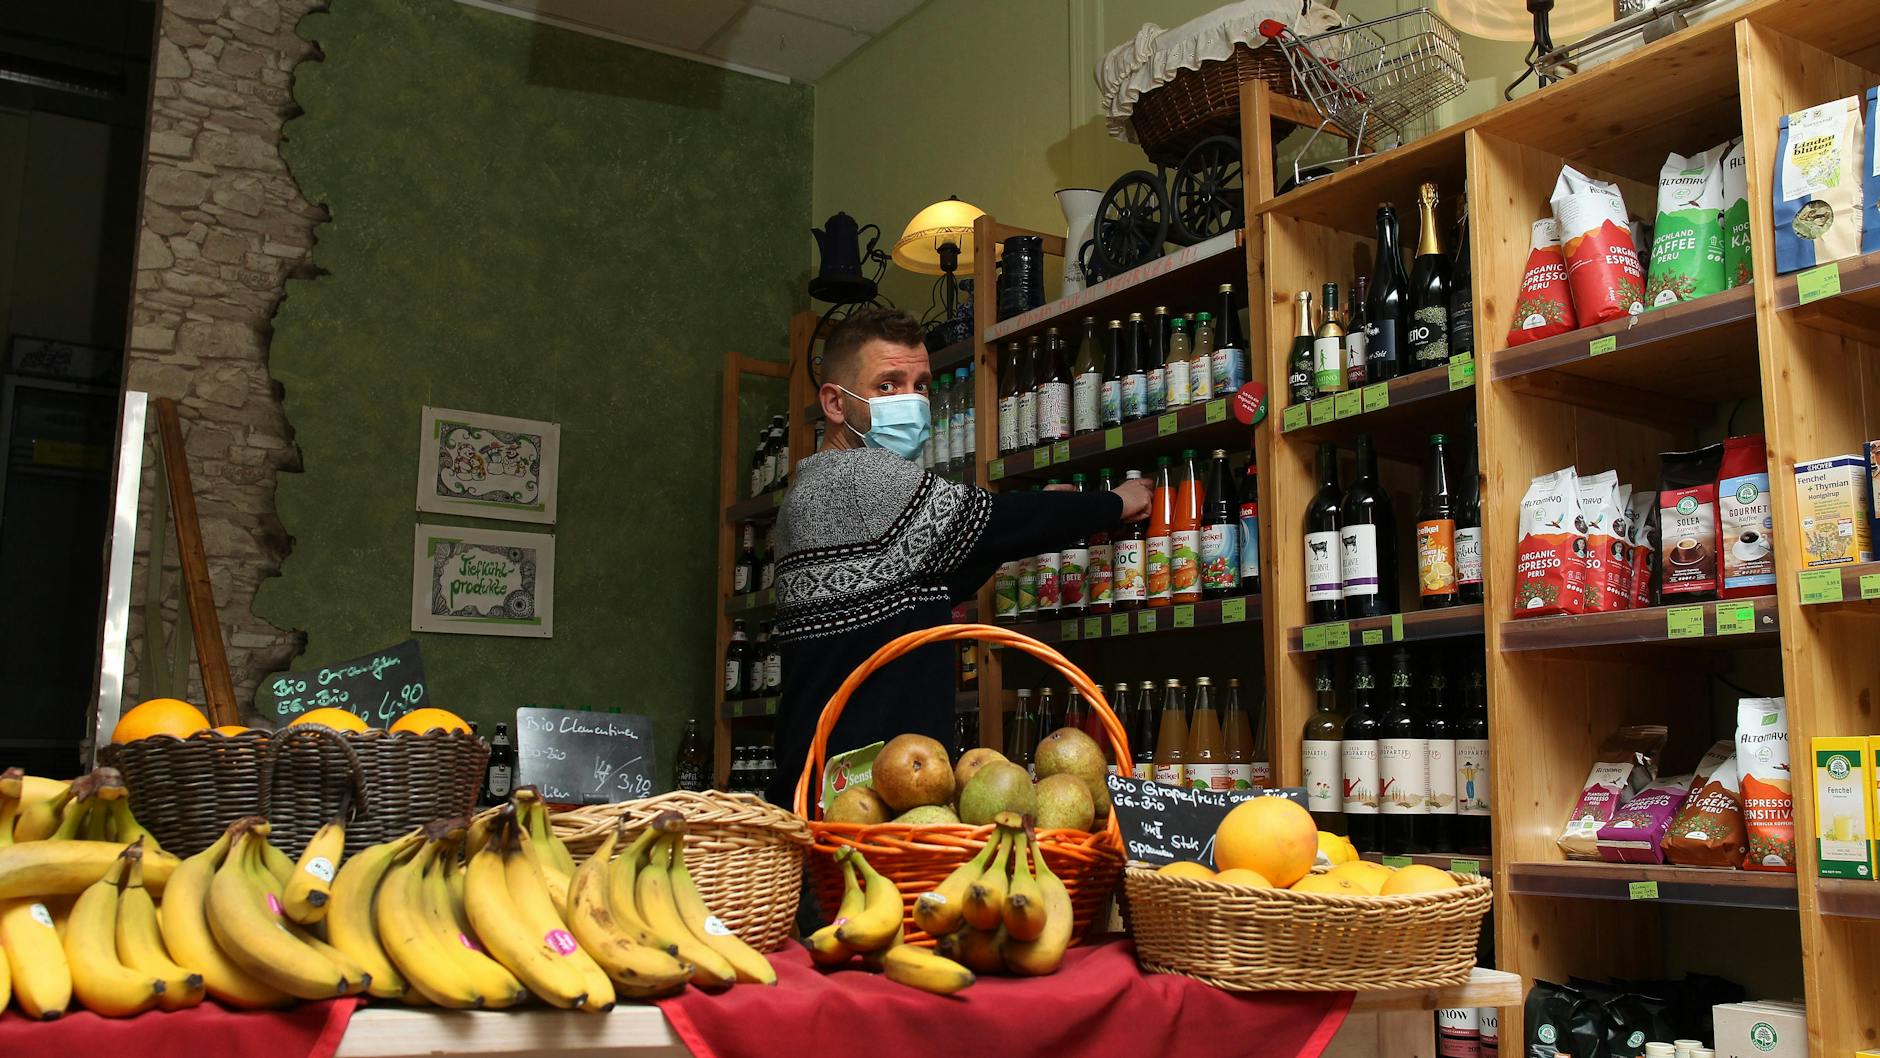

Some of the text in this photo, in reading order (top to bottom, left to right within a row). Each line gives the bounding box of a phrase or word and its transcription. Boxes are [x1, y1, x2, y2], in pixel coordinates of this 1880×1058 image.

[1793, 134, 1836, 150] Linden
[1657, 252, 1679, 265] PERU
[1527, 282, 1550, 293] PERU
[1316, 375, 1337, 385] AMINO
[1811, 462, 1833, 471] HOYER
[1797, 474, 1826, 485] Fenchel
[1815, 479, 1849, 491] Thymian
[1582, 497, 1602, 505] MAYO
[1808, 490, 1840, 501] Honigsirup
[1729, 505, 1768, 518] GOURMET
[1676, 517, 1700, 527] SOLEA
[1521, 550, 1556, 561] ORGANIC
[1174, 557, 1188, 566] HRE
[1527, 569, 1545, 578] PERU
[450, 577, 508, 609] produkte
[272, 679, 307, 697] Bio
[527, 716, 639, 739] Bio Clementinen
[617, 773, 652, 793] 3,90
[1108, 774, 1137, 794] Bio
[1142, 780, 1226, 807] Grapefruit
[1827, 786, 1852, 794] Fenchel
[1700, 806, 1724, 815] PERU
[1128, 840, 1175, 859] Spanien
